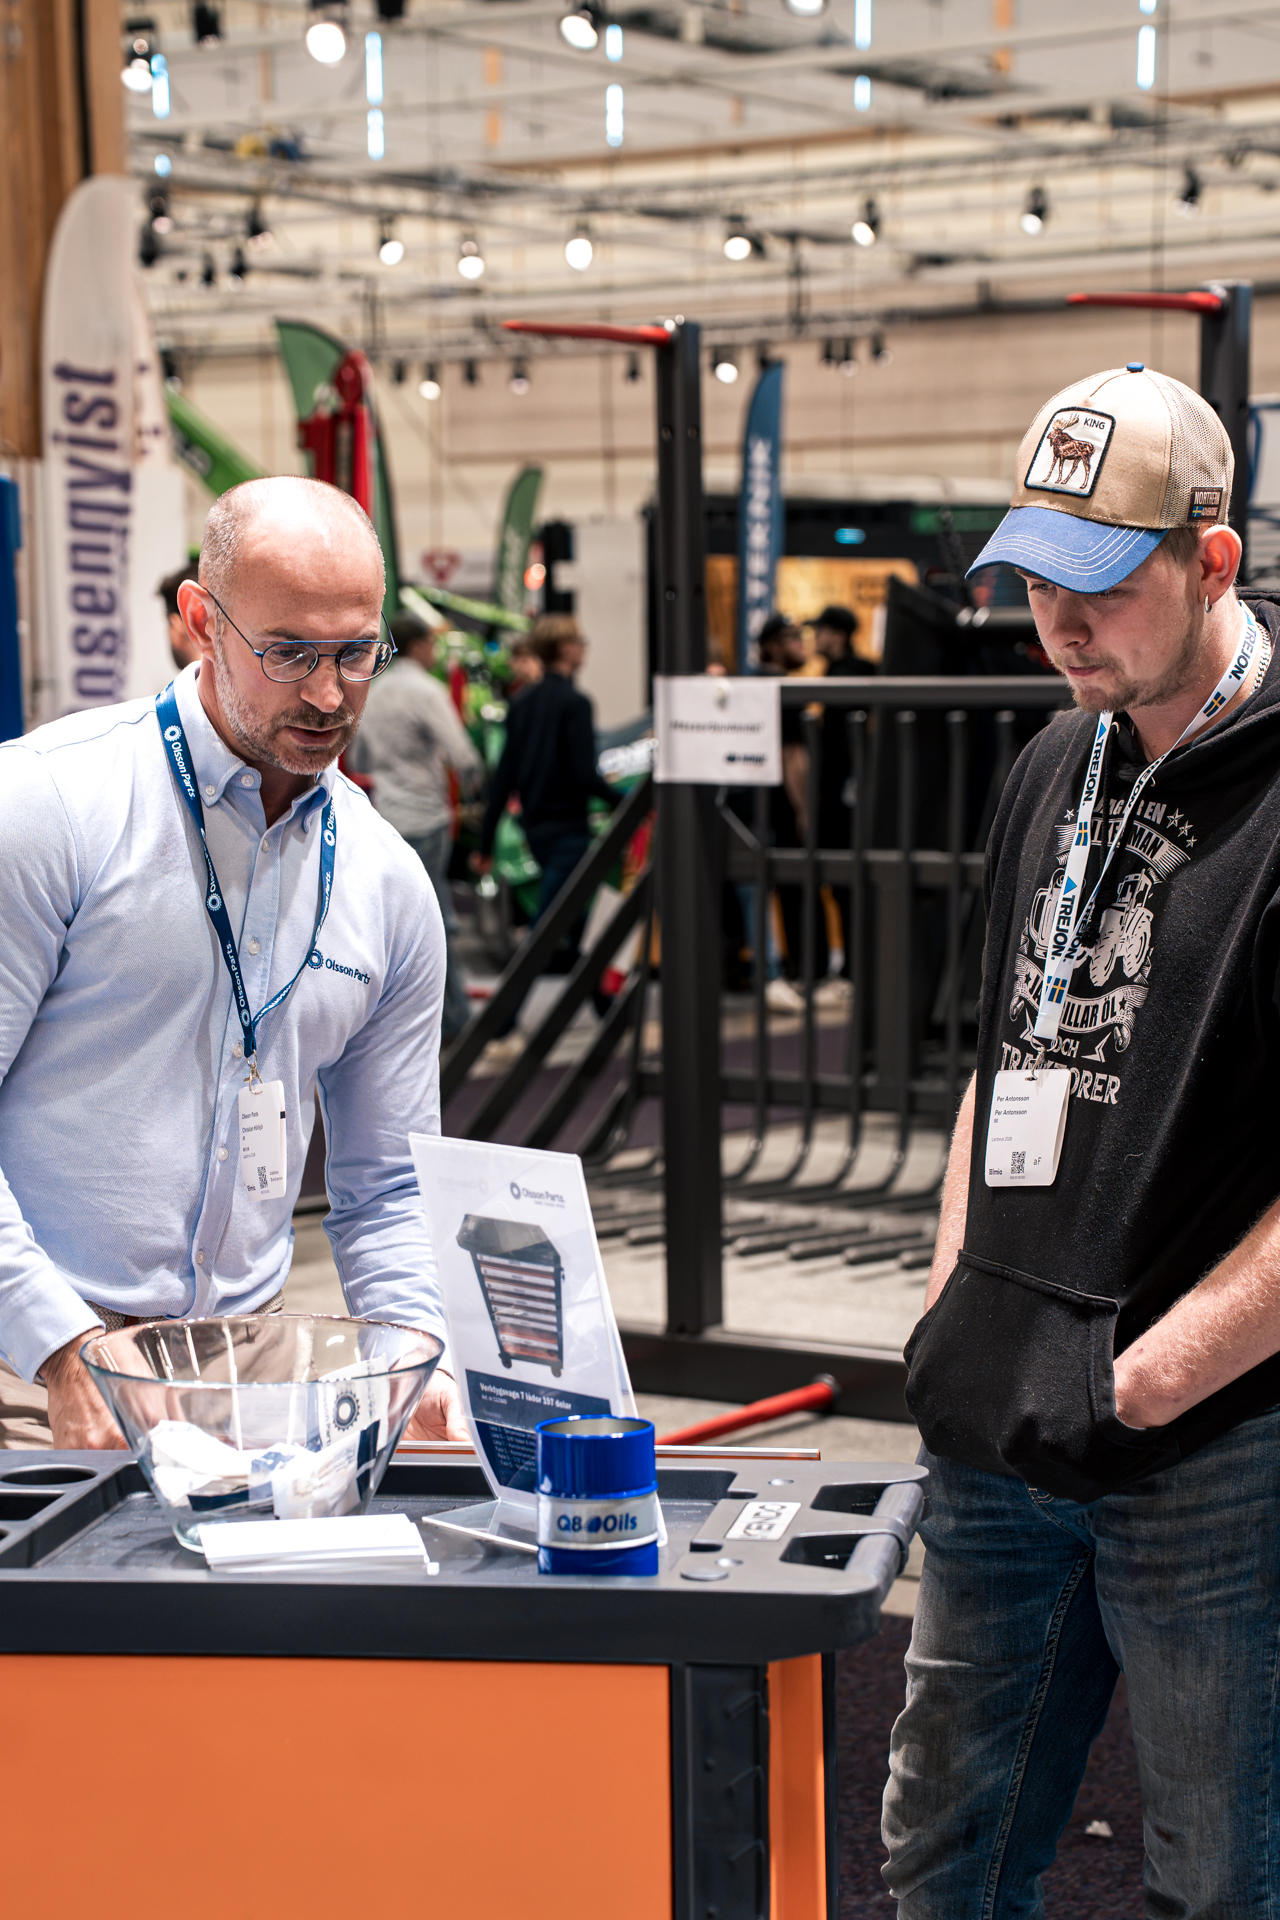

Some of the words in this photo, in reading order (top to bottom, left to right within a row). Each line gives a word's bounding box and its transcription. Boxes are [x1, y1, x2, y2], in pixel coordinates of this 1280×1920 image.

[1083, 417, 1106, 430] KING
[54, 362, 132, 712] osenqvist
[171, 741, 187, 775] Olsson
[1143, 801, 1167, 825] EN
[1127, 824, 1164, 859] MAN
[325, 958, 354, 978] Olsson
[234, 971, 246, 1008] Olsson
[1060, 1001, 1099, 1028] ILLAR
[1101, 995, 1117, 1022] ÖL
[556, 1514, 583, 1533] Q8
[603, 1512, 638, 1533] Oils
